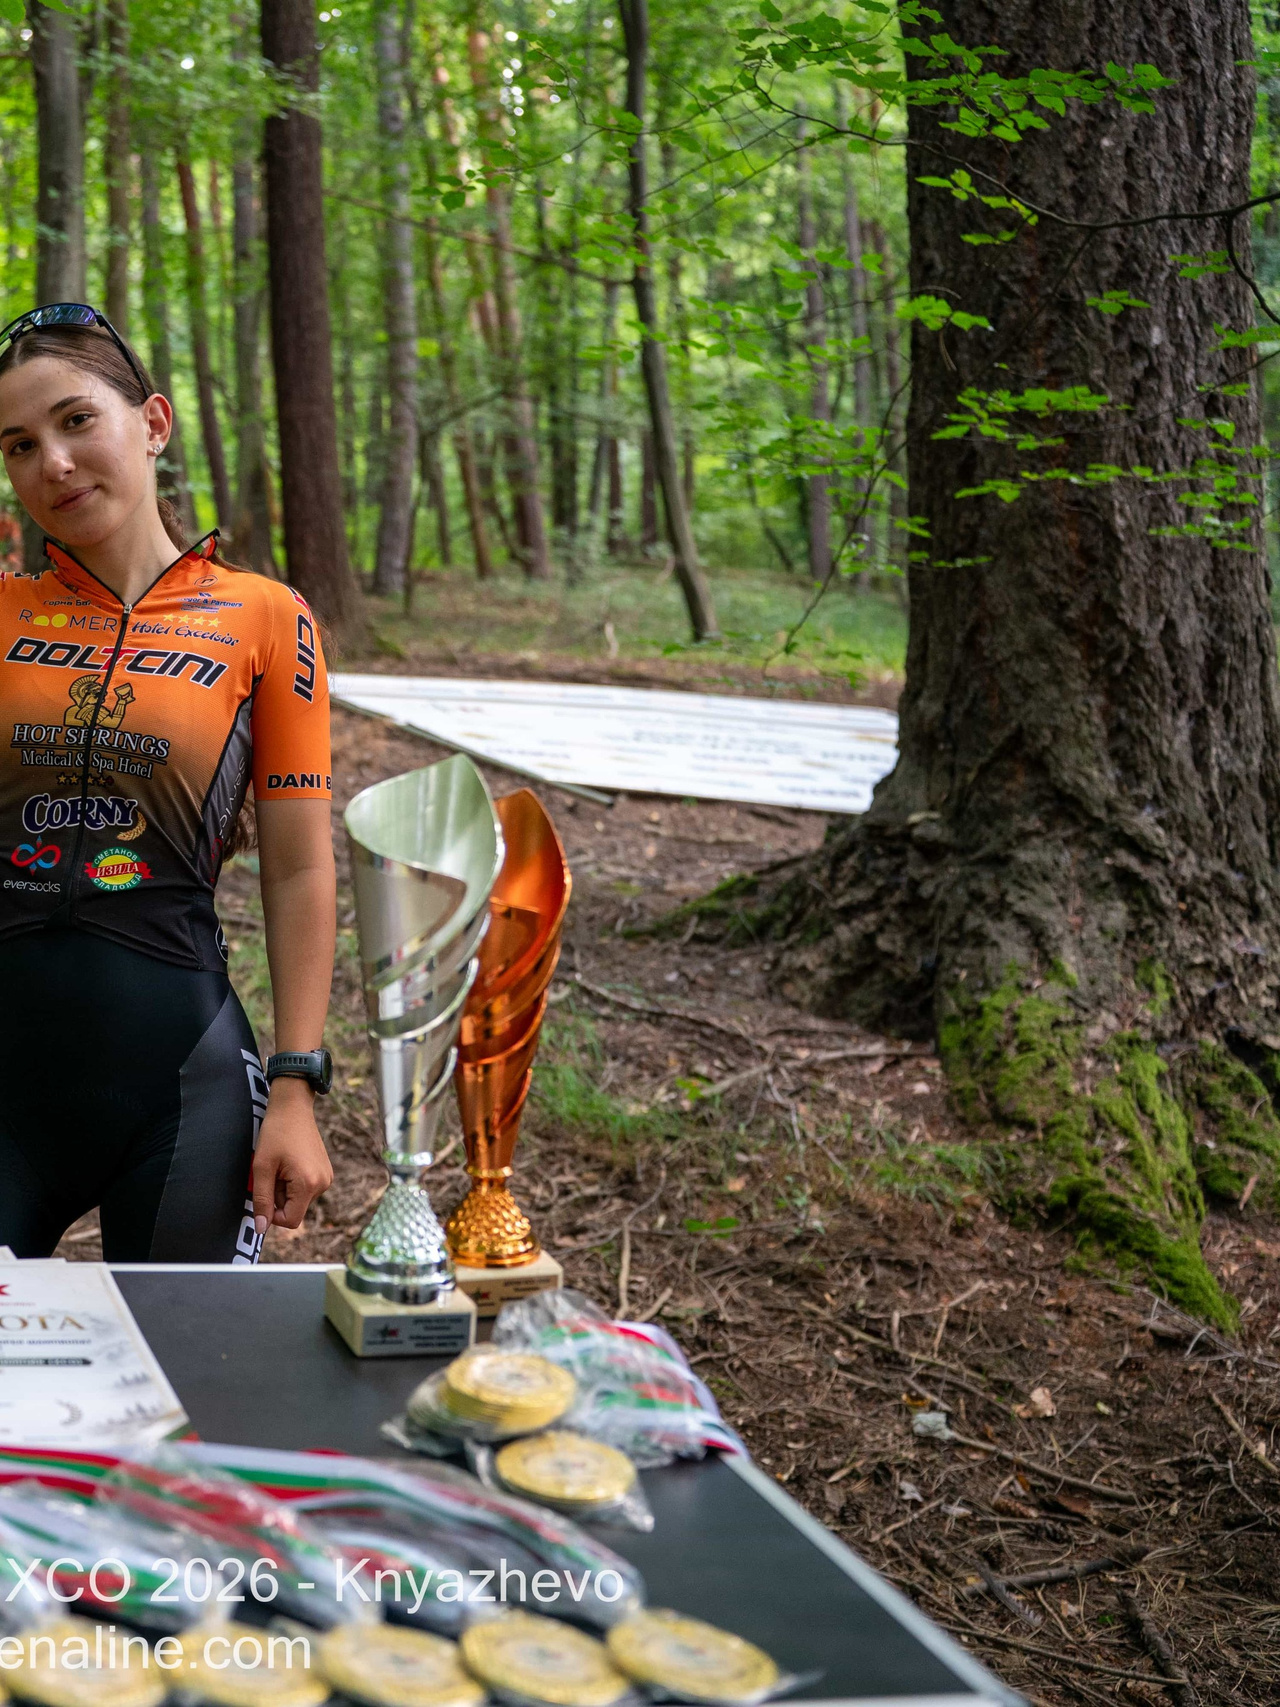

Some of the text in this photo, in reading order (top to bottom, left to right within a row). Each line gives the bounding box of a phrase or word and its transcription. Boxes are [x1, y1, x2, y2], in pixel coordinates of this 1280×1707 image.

[131, 622, 240, 646] Hotel Excelsior
[4, 636, 229, 689] DOLTCINI
[12, 724, 170, 758] HOT SPRINGS
[22, 750, 153, 778] Medical & Spa Hotel
[267, 773, 321, 790] DANI
[93, 848, 138, 865] СМЕТАНОВ
[95, 862, 139, 878] ИЗИДА
[3, 879, 61, 893] eversocks
[93, 873, 143, 891] СЛАДОЛЕД
